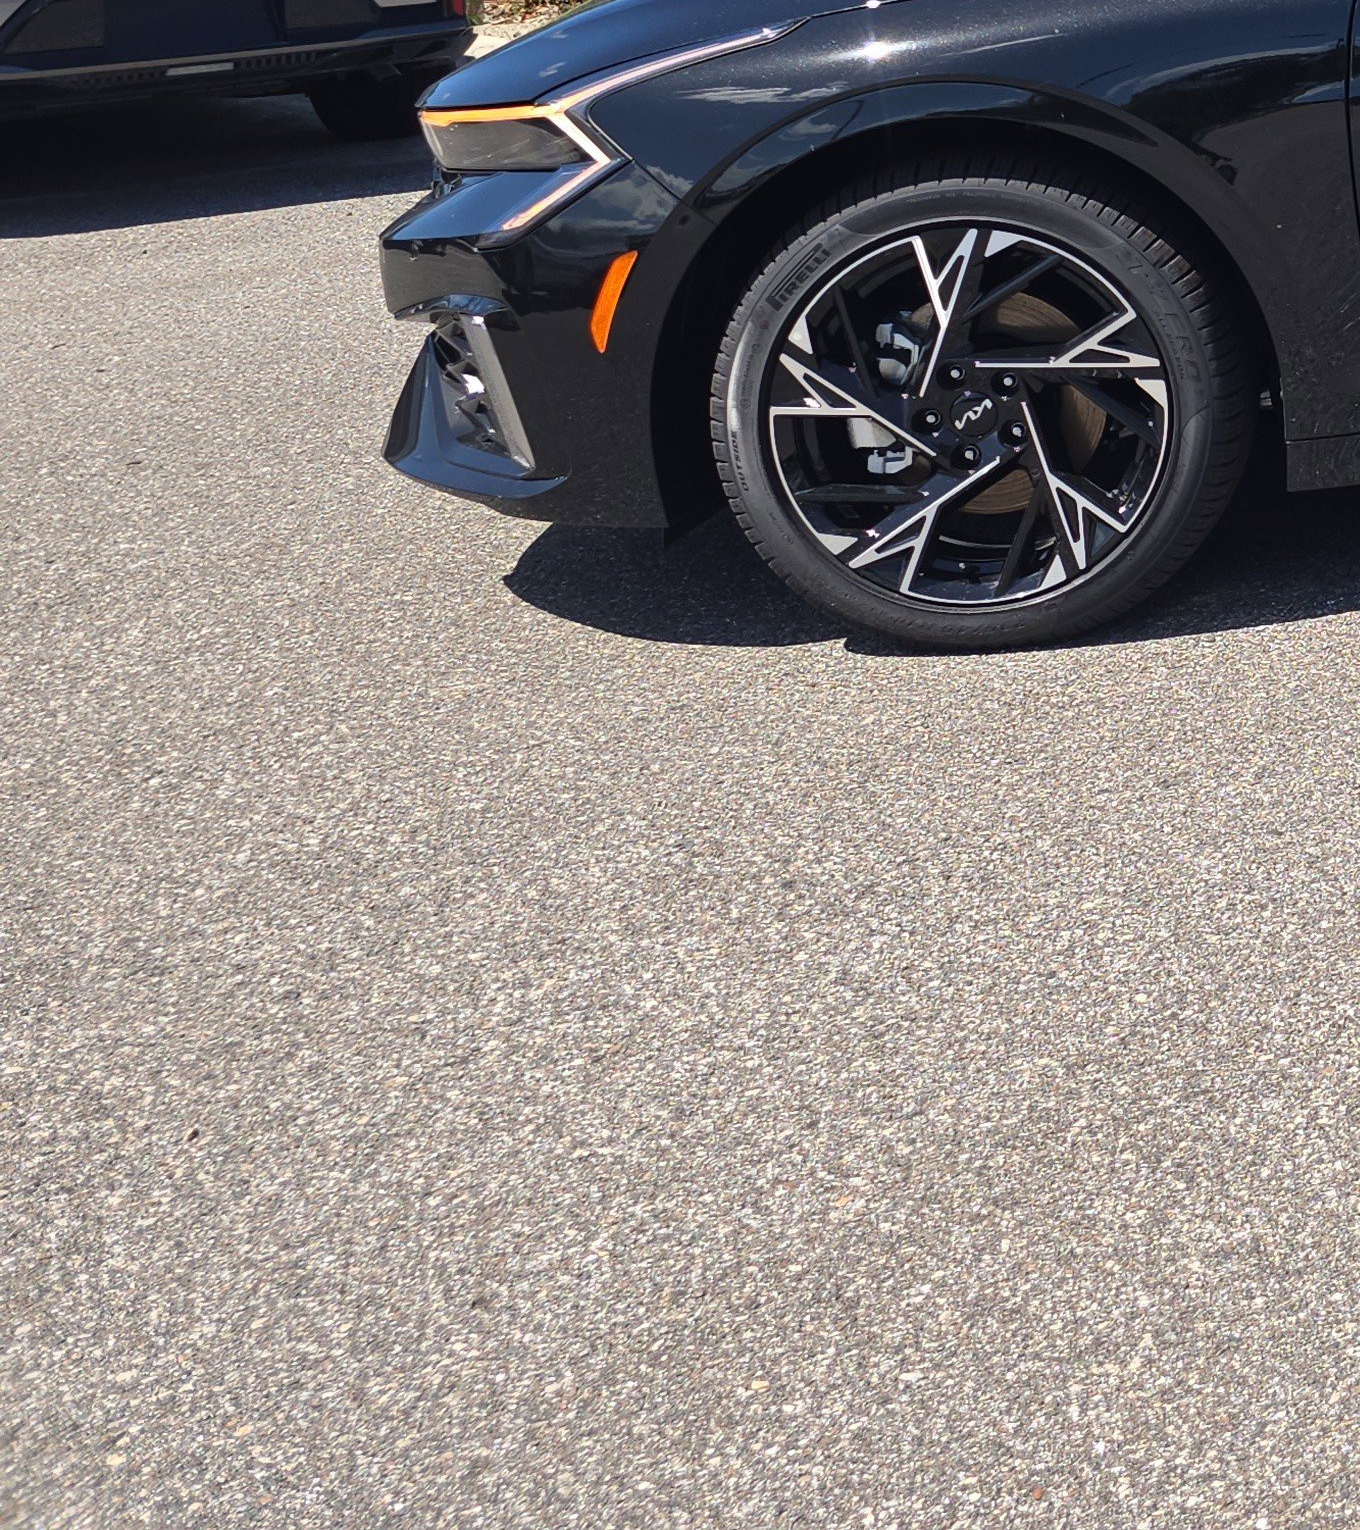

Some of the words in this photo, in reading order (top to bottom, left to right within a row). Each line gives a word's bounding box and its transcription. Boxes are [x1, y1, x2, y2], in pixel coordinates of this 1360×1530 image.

[765, 243, 831, 311] PIRELLI
[954, 398, 993, 430] KIA
[731, 431, 750, 492] OUTSIDE
